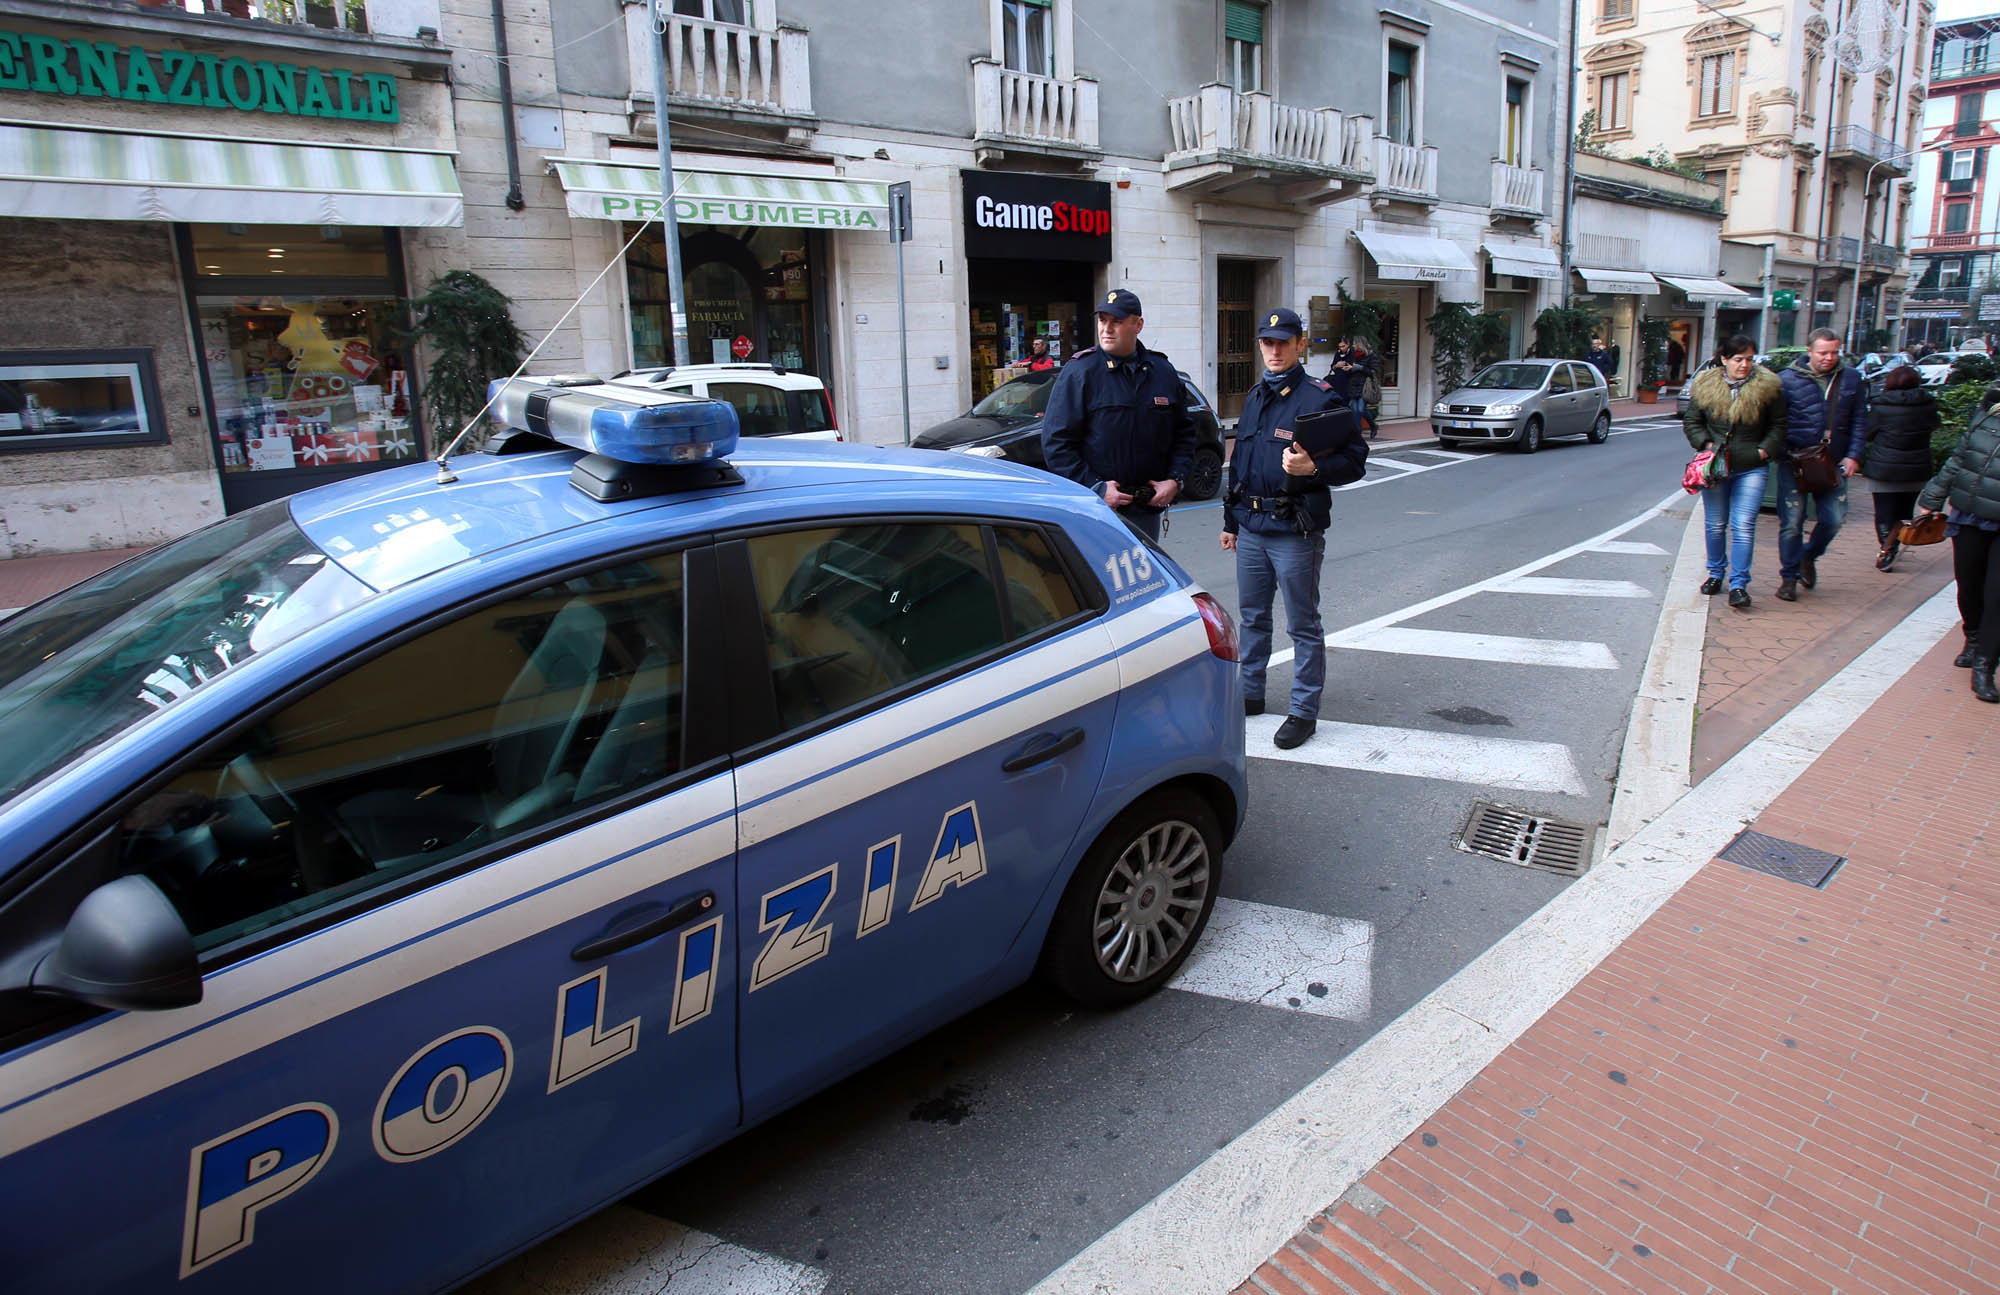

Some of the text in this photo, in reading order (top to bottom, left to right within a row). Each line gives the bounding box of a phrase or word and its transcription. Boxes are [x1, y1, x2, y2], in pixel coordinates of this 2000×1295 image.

[601, 197, 878, 227] PROFUMERIA
[976, 195, 1109, 236] GameStop
[692, 312, 745, 321] FARMACIA
[1105, 546, 1152, 591] 113
[179, 800, 988, 1280] POLIZIA
